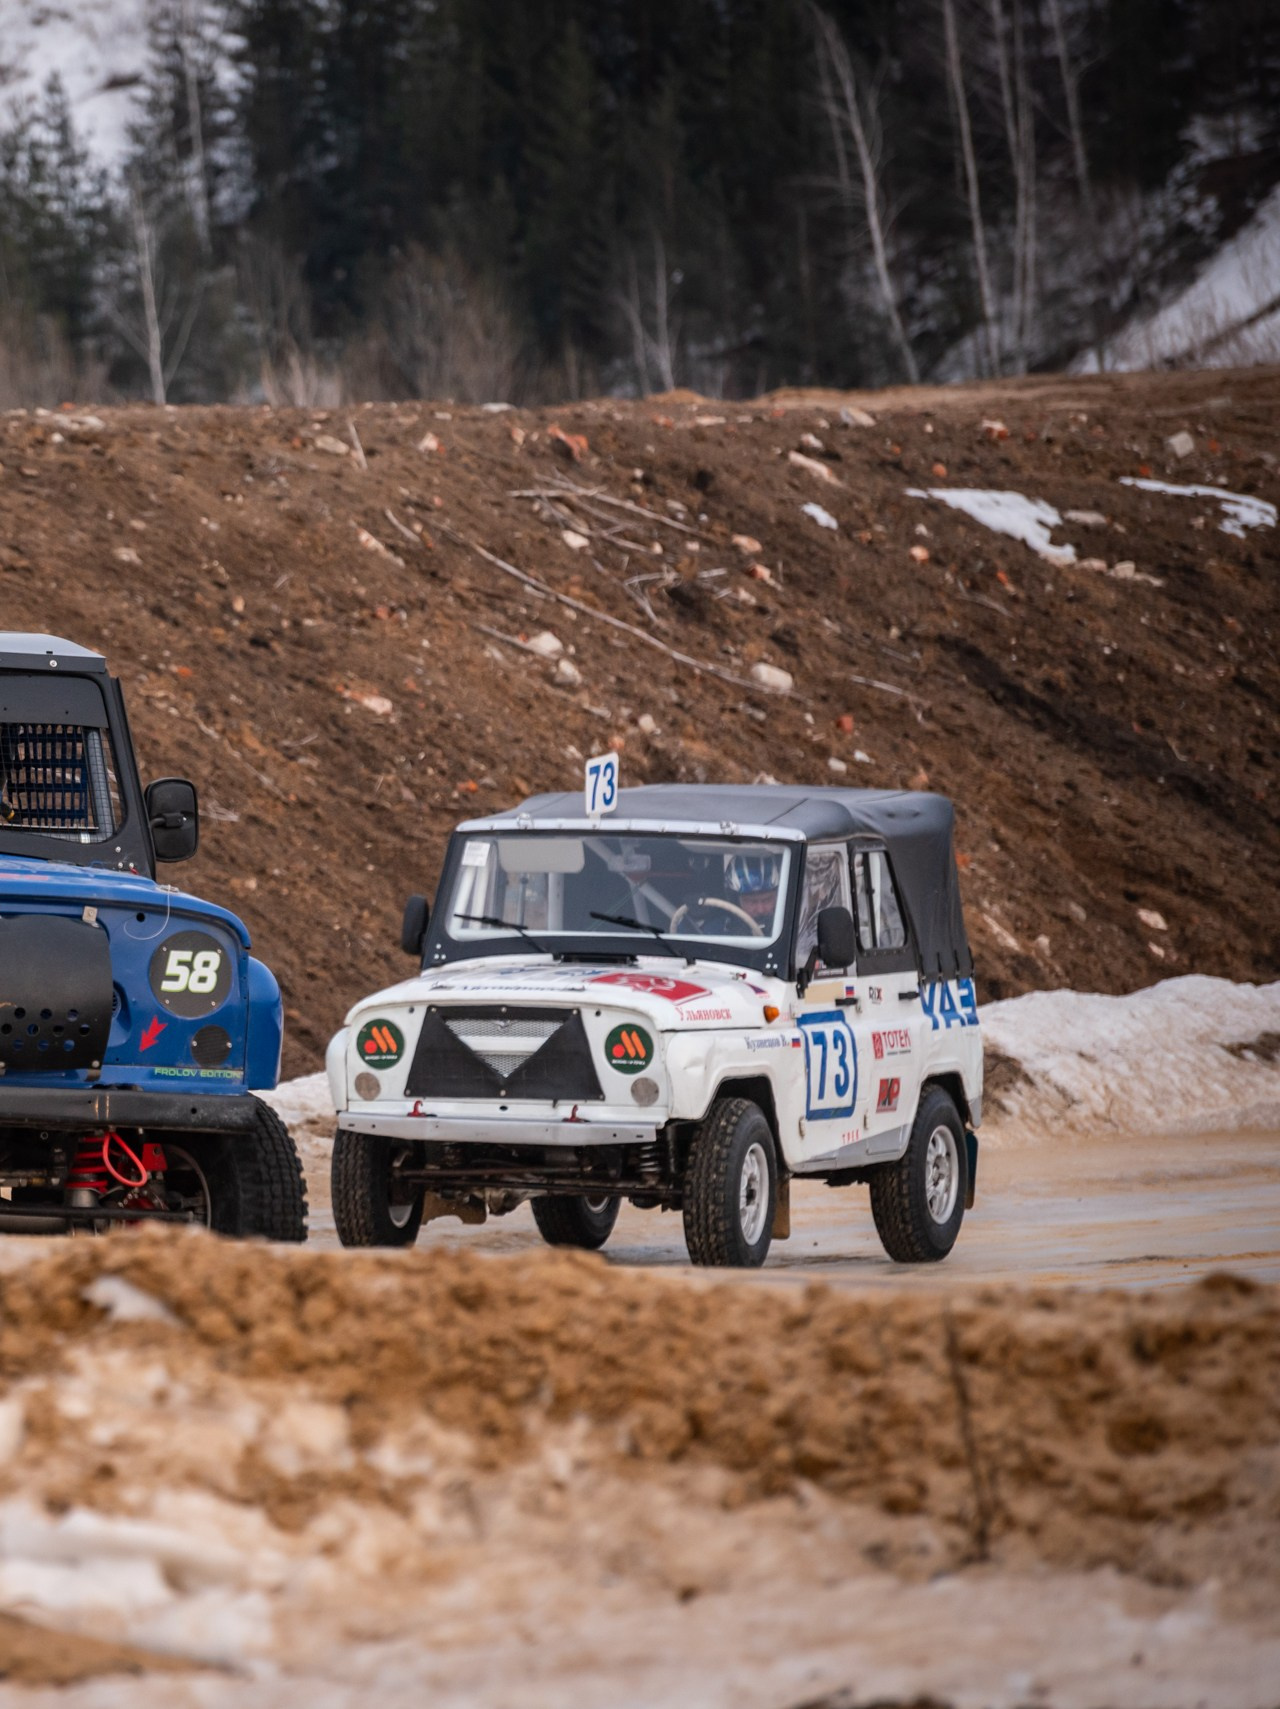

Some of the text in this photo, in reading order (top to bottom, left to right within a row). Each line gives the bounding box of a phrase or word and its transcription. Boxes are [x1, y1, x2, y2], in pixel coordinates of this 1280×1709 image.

[589, 762, 615, 811] 73
[160, 949, 221, 994] 58
[154, 1067, 244, 1080] FROLOV EDITION
[811, 1029, 850, 1101] 73
